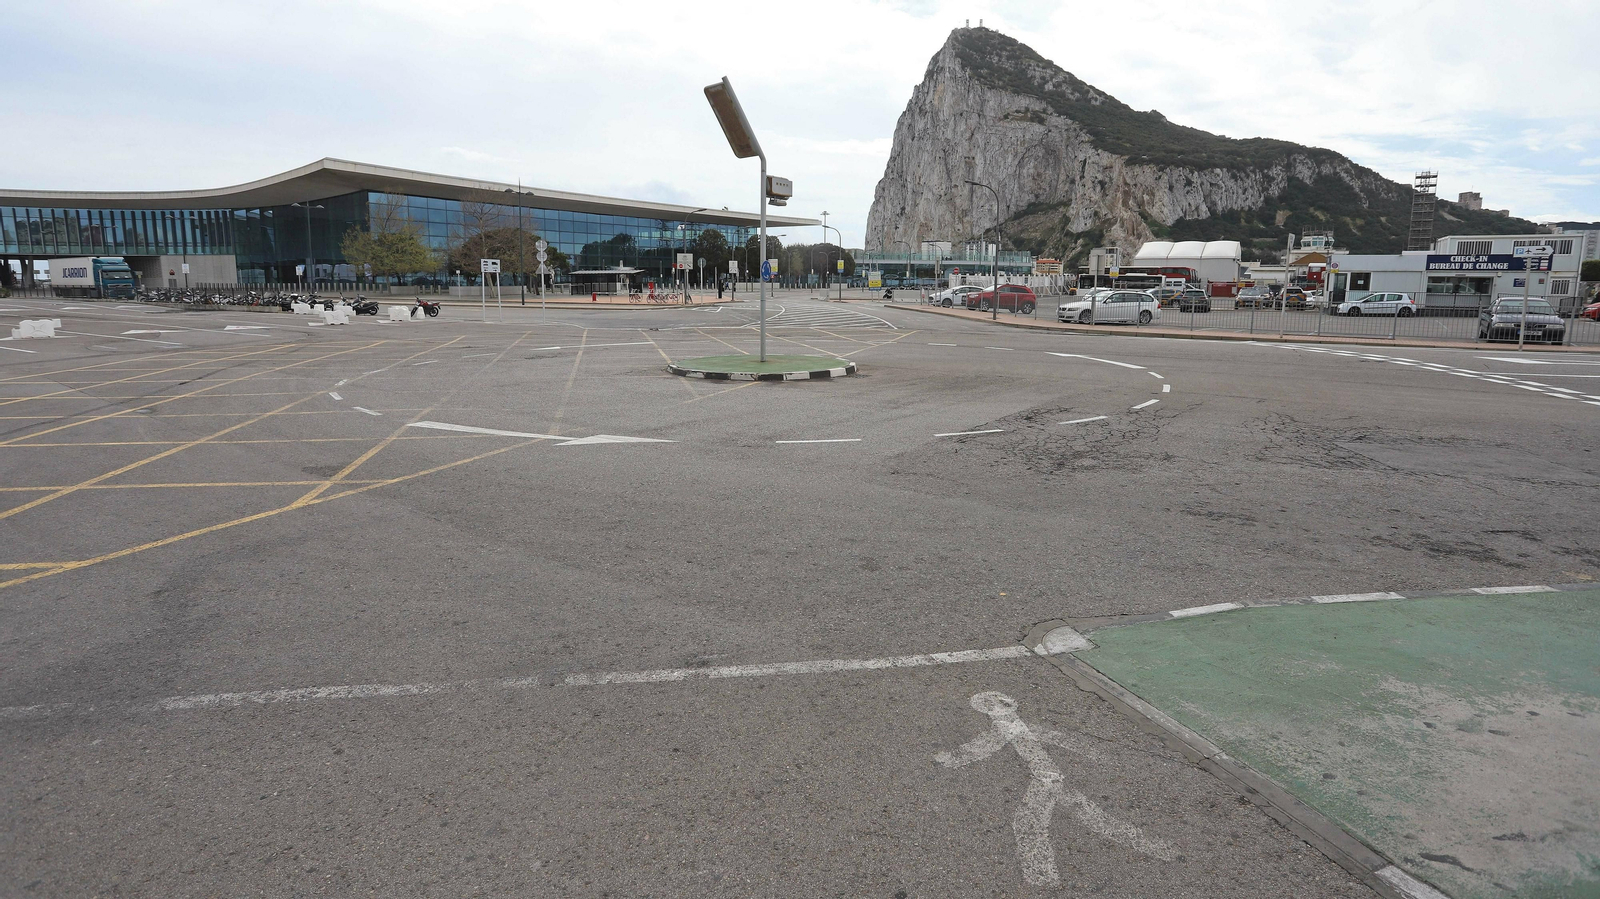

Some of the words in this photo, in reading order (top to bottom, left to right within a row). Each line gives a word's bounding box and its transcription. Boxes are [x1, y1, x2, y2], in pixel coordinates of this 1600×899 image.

[1429, 262, 1460, 270] BUREAU
[1462, 262, 1474, 270] DE
[1476, 262, 1509, 270] CHANGE
